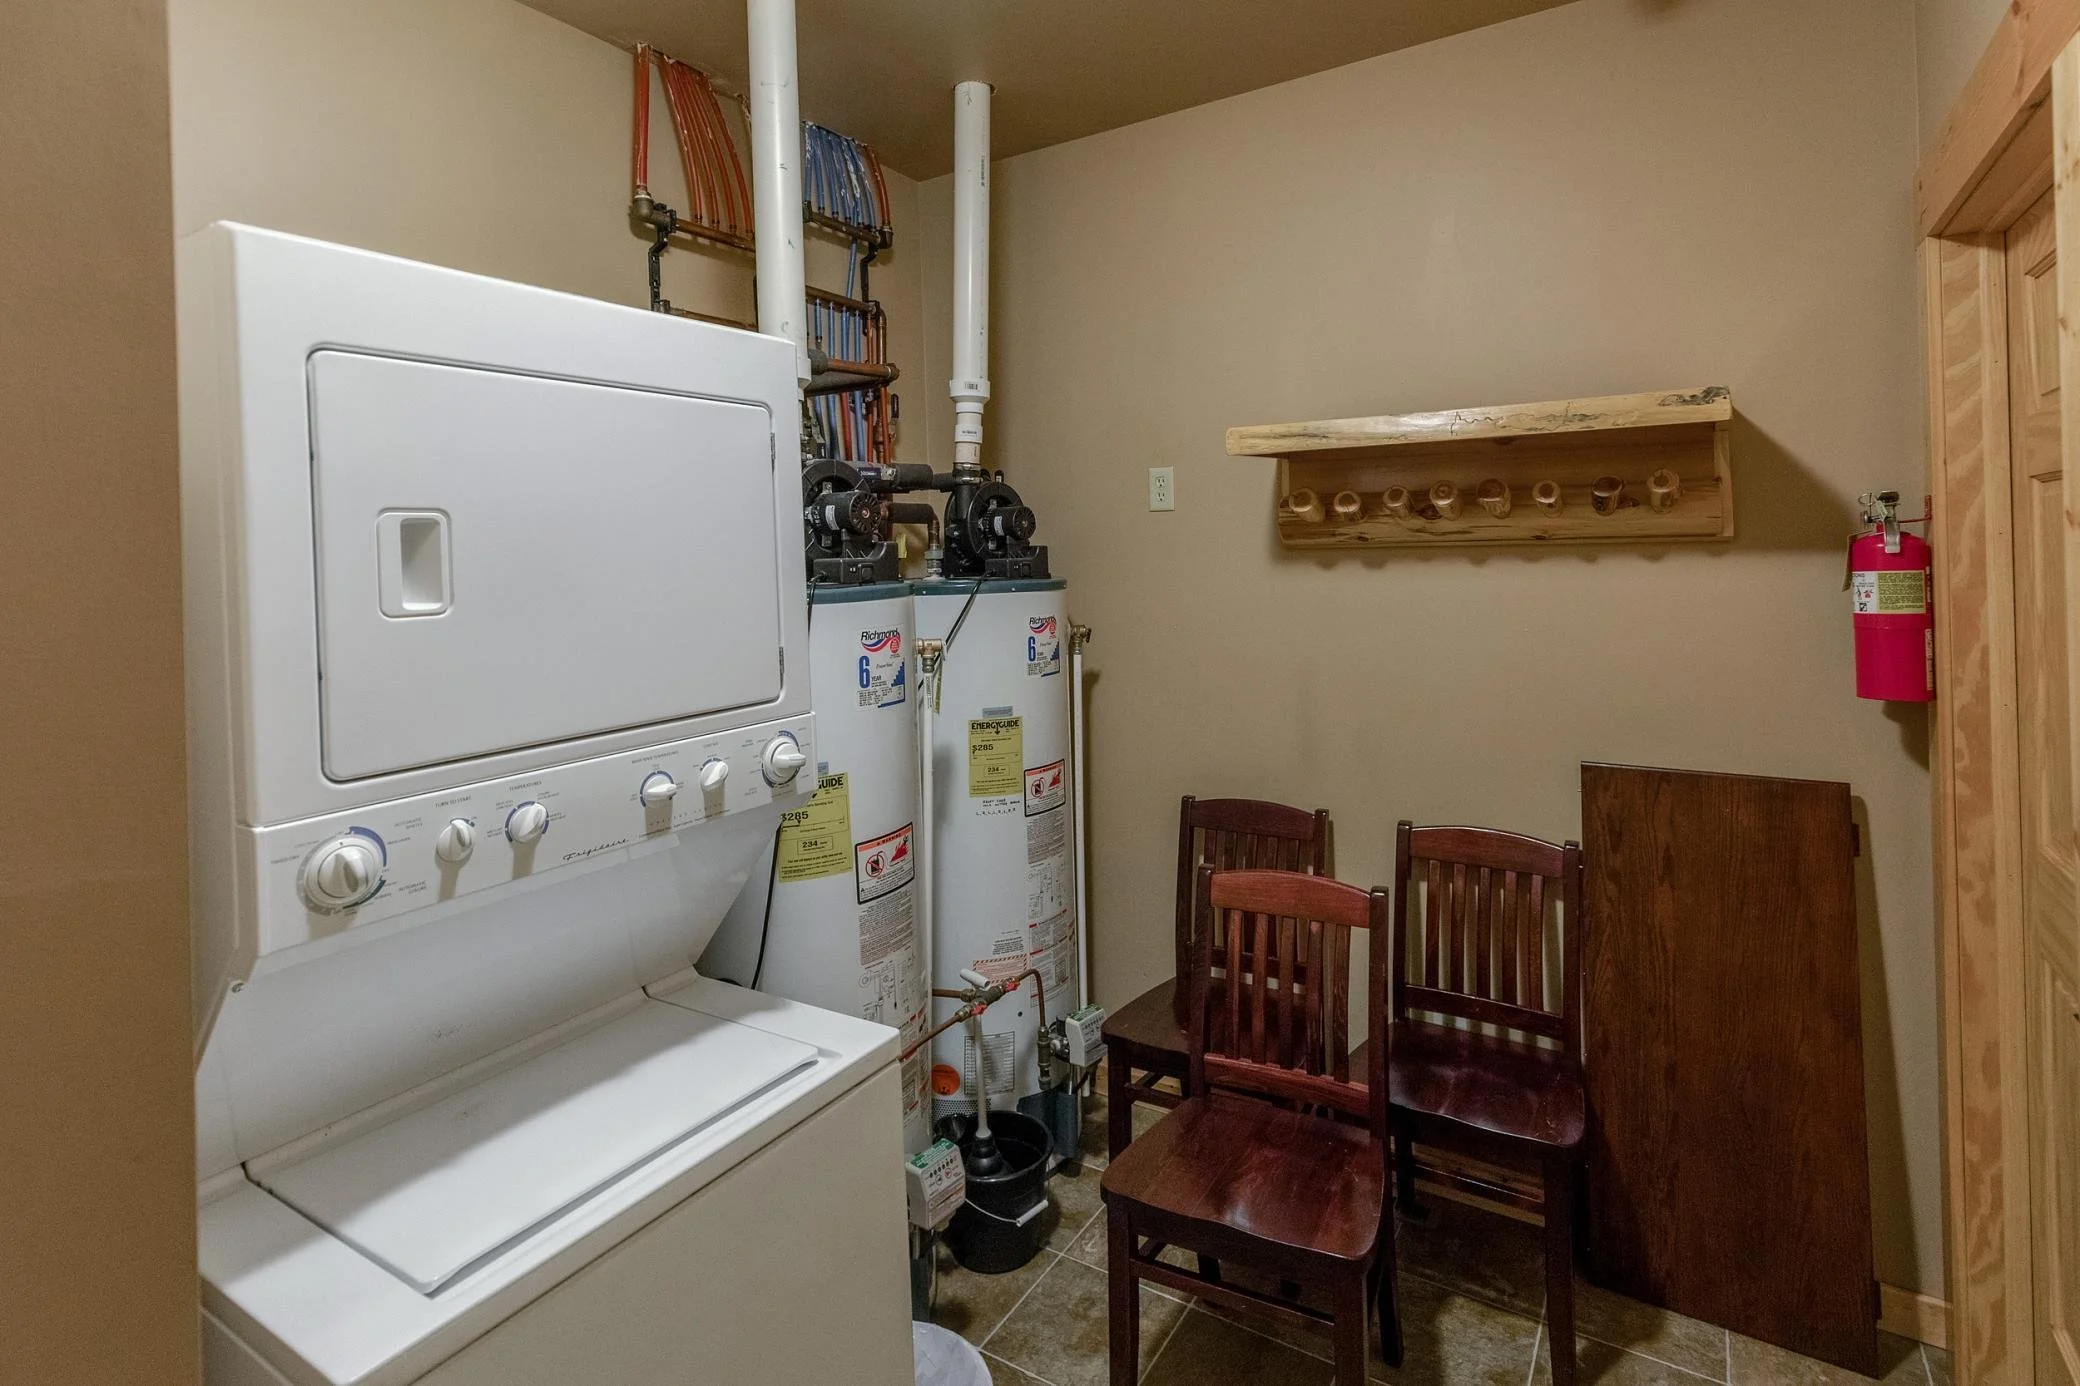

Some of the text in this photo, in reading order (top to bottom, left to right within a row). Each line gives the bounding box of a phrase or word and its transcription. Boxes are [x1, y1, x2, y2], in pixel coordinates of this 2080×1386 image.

[1029, 614, 1057, 625] Richmond
[861, 628, 898, 642] Richmond
[1028, 636, 1036, 662] 6
[859, 655, 870, 689] 6
[971, 719, 1020, 731] ENERGYGUIDE
[971, 743, 994, 752] $285
[562, 837, 629, 861] Frigidaire
[801, 839, 818, 849] 234
